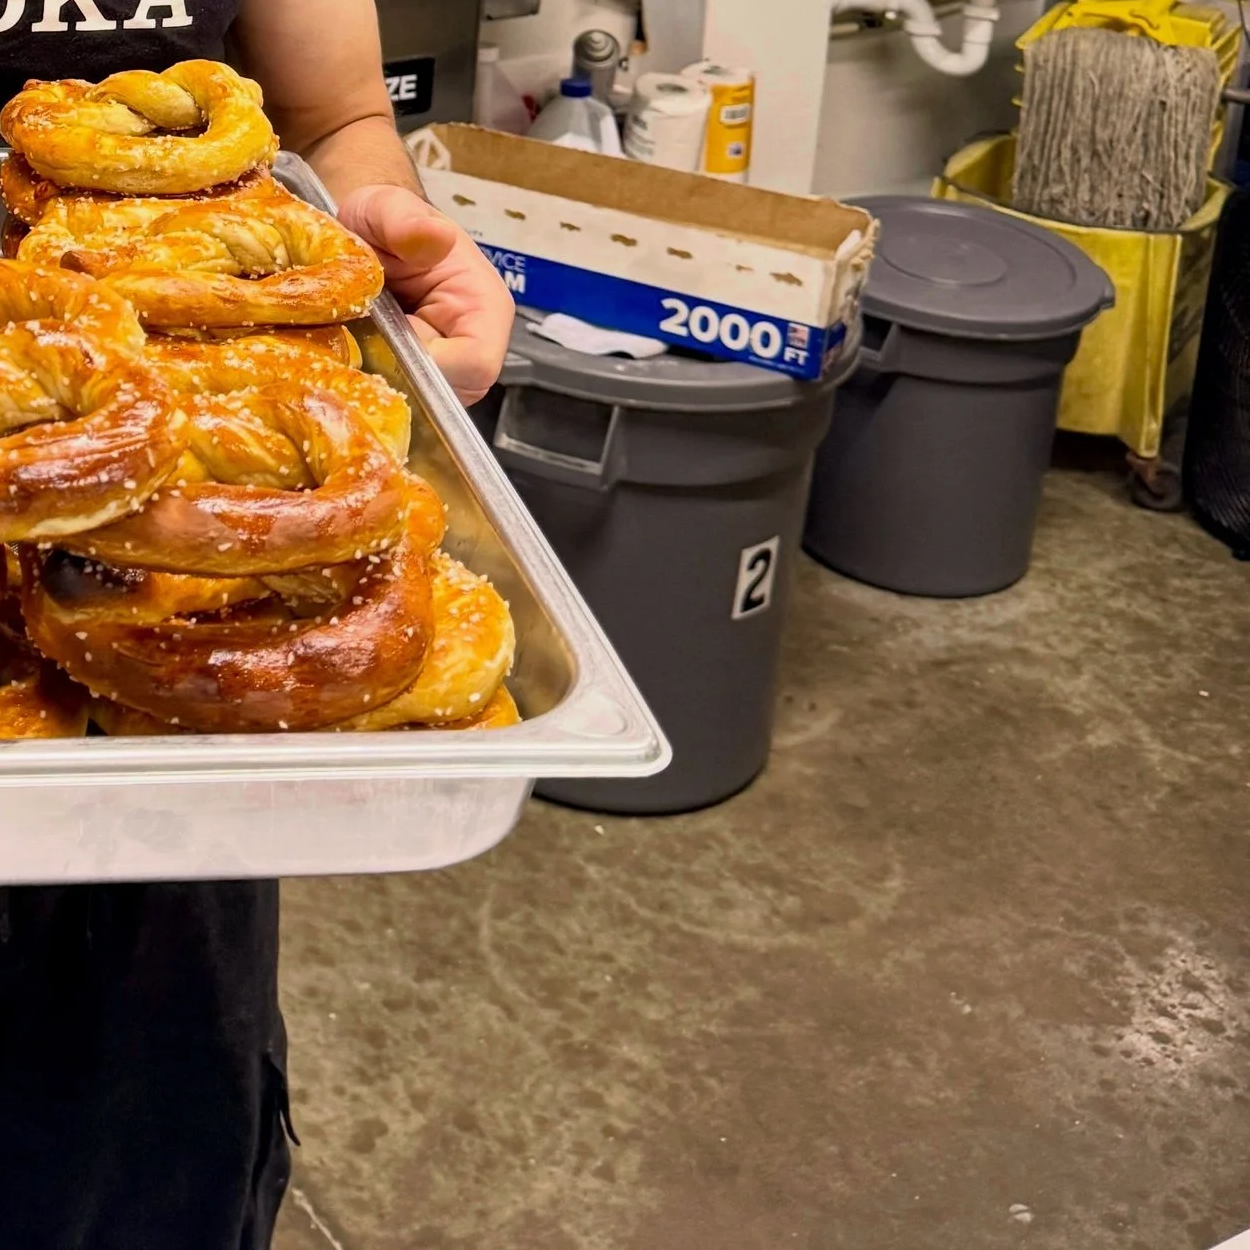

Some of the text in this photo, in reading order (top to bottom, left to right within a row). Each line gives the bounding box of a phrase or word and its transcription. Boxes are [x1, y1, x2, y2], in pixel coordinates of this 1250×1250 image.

[385, 73, 418, 101] ZE
[659, 298, 782, 359] 2000
[783, 346, 810, 366] FT
[740, 548, 772, 613] 2
